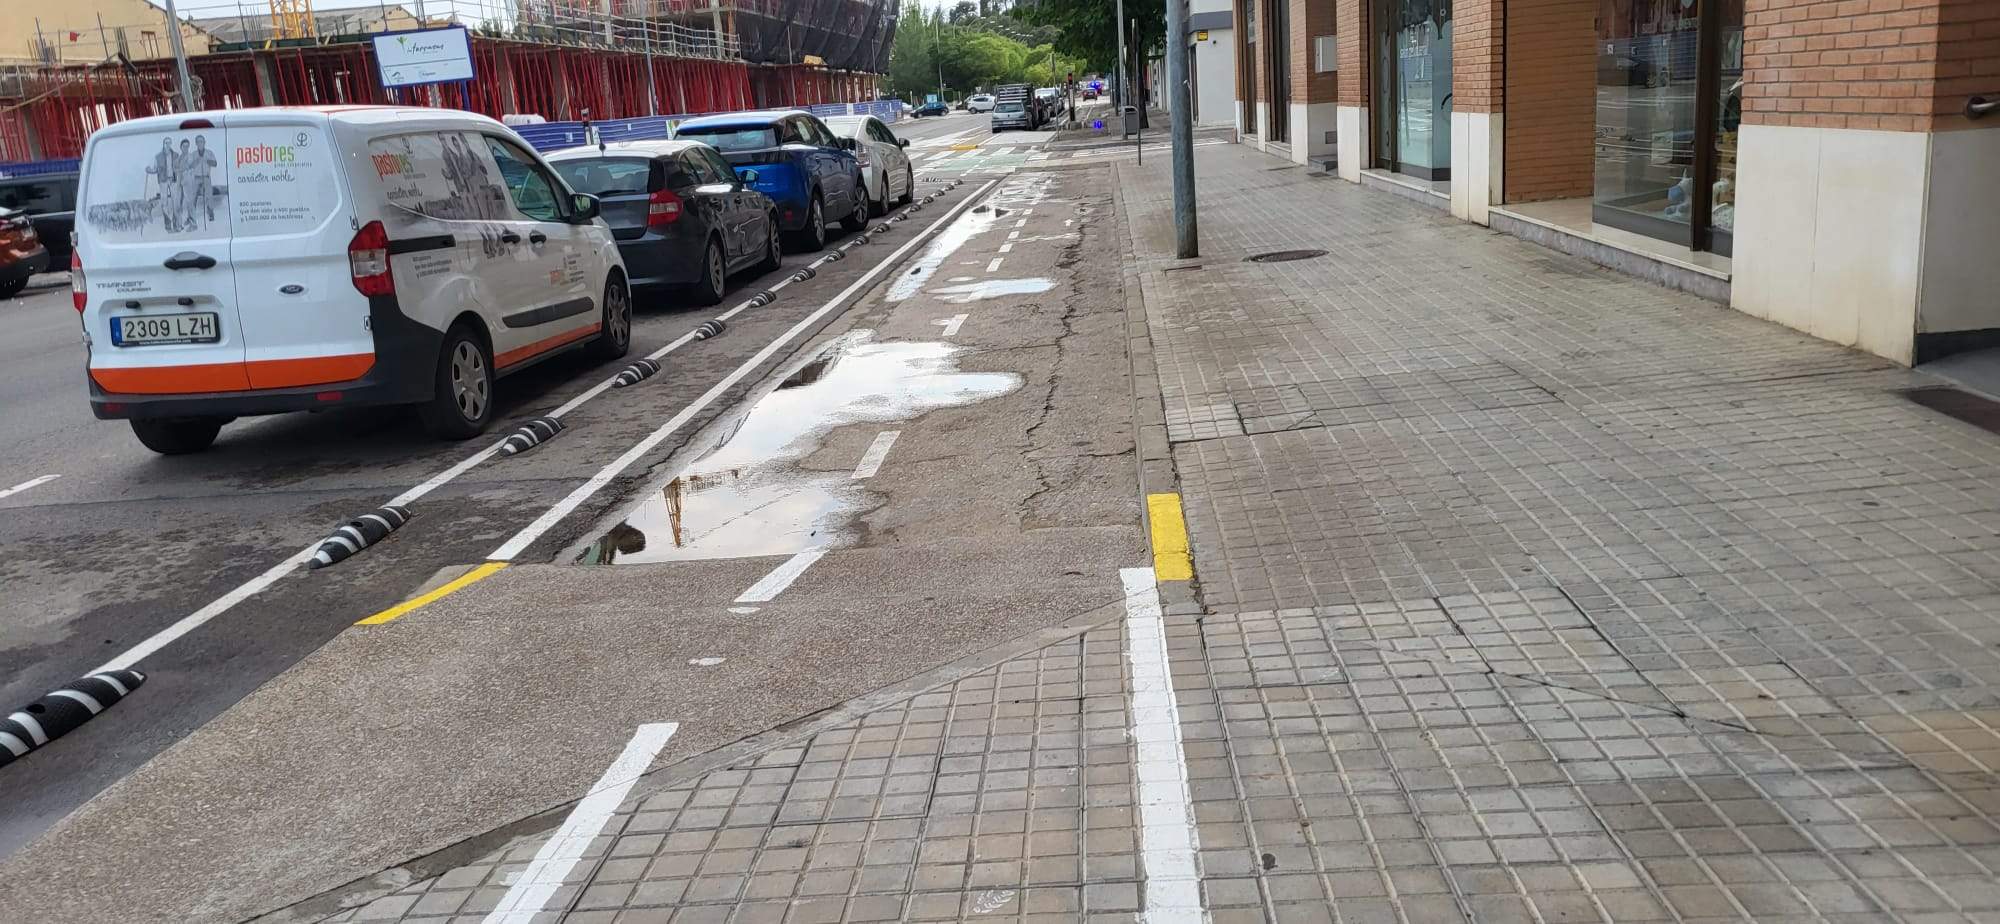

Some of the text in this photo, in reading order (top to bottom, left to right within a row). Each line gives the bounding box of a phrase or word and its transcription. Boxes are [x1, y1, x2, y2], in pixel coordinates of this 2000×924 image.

[237, 143, 295, 168] pastores
[371, 150, 414, 182] pastores
[238, 169, 295, 183] carácter noble
[96, 280, 145, 289] TRANSIT
[125, 317, 212, 339] 2309 LZH
